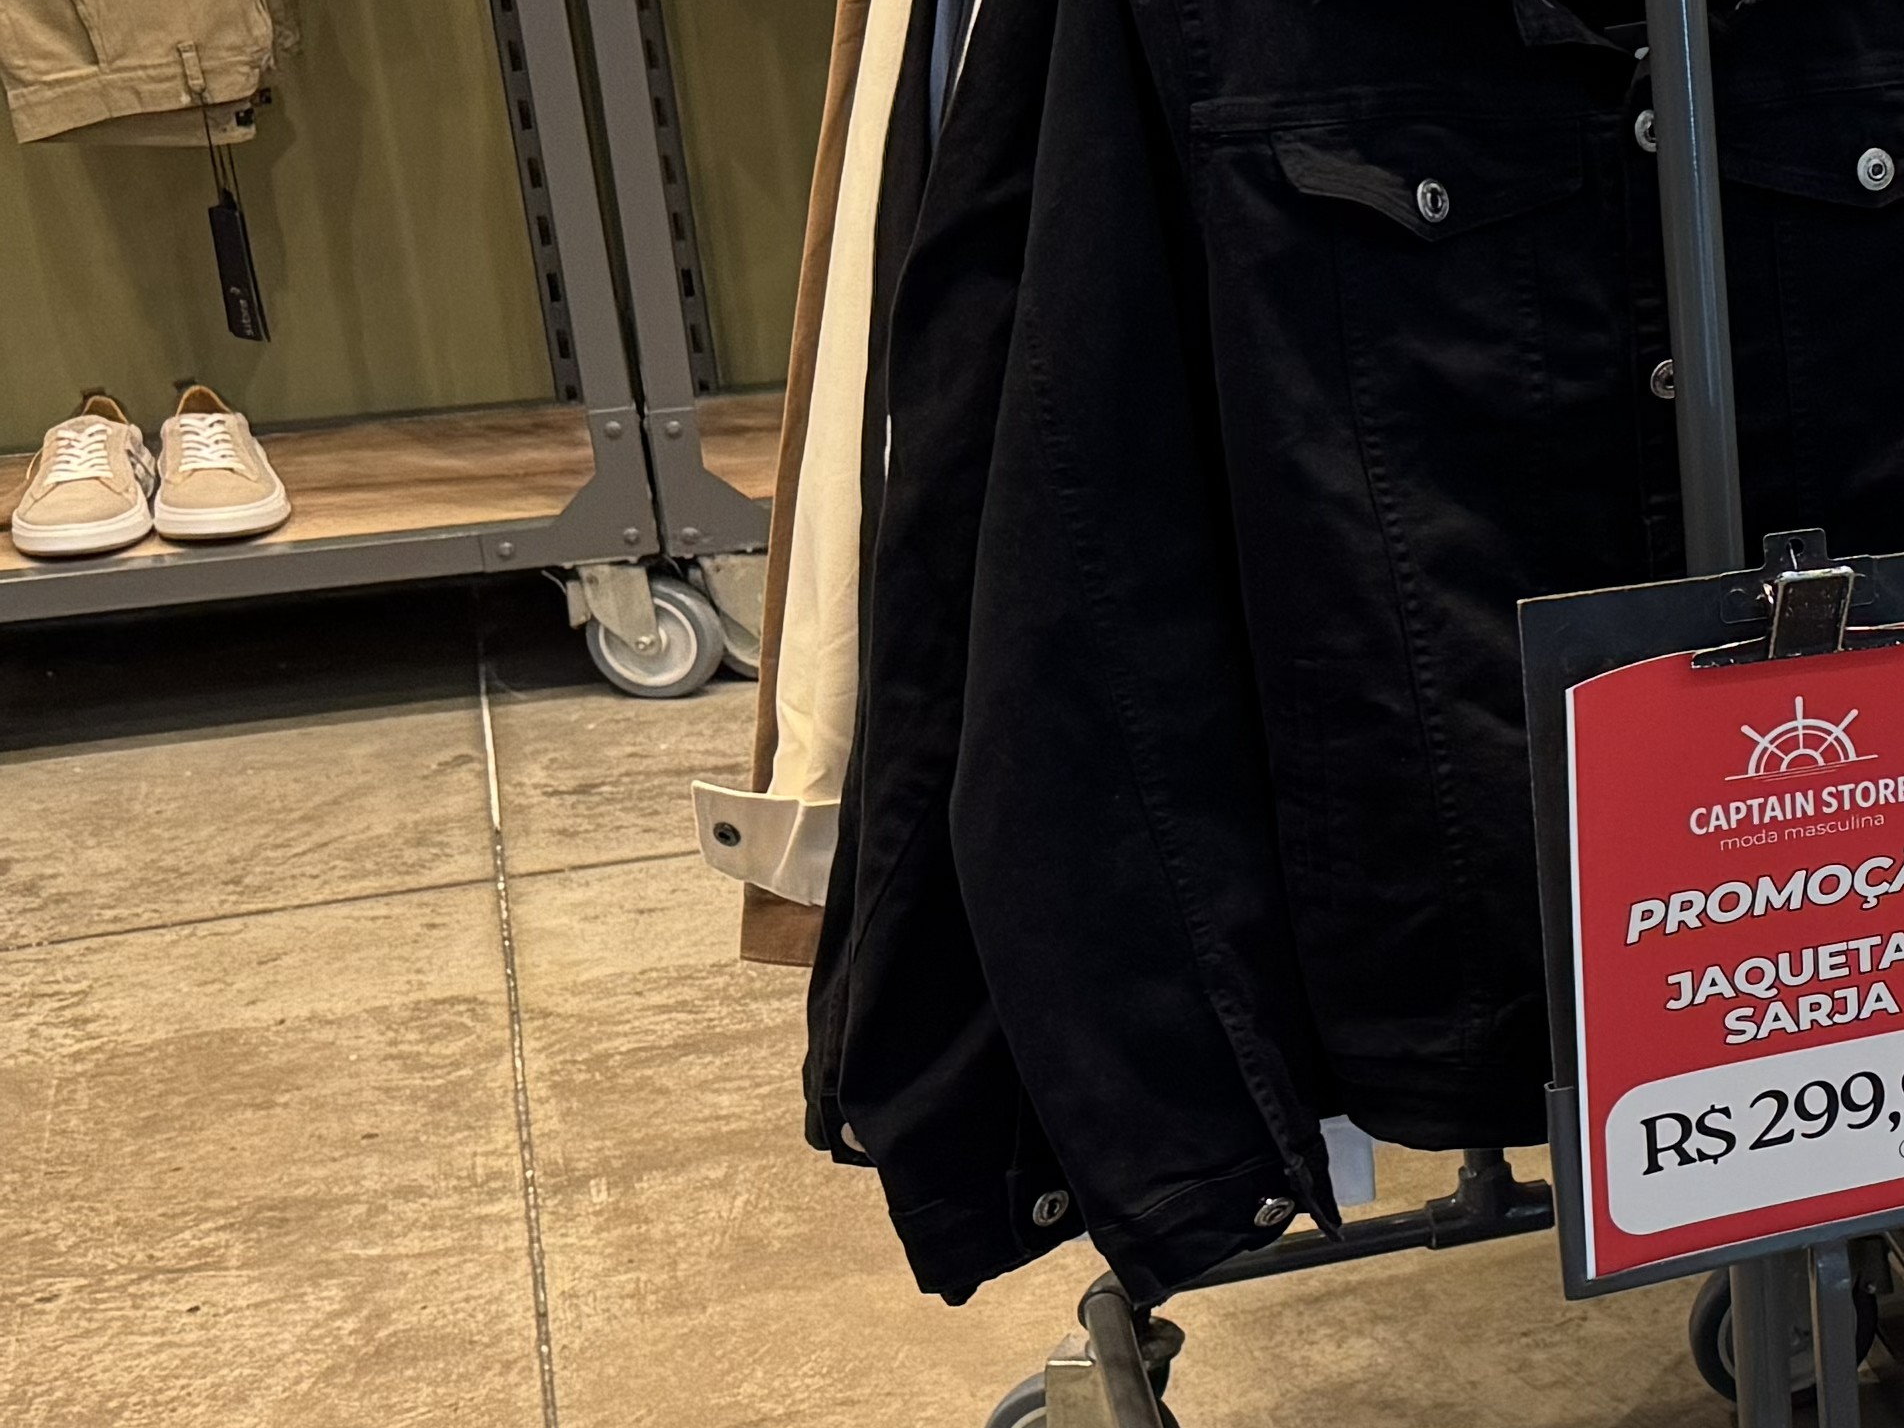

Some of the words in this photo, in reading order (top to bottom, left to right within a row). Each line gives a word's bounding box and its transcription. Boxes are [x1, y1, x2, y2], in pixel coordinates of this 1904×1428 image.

[1688, 789, 1816, 836] CAPTAIN
[1719, 828, 1779, 852] moda
[1784, 813, 1886, 843] masculina
[1723, 981, 1901, 1046] SARJA
[1639, 1103, 1737, 1176] R$
